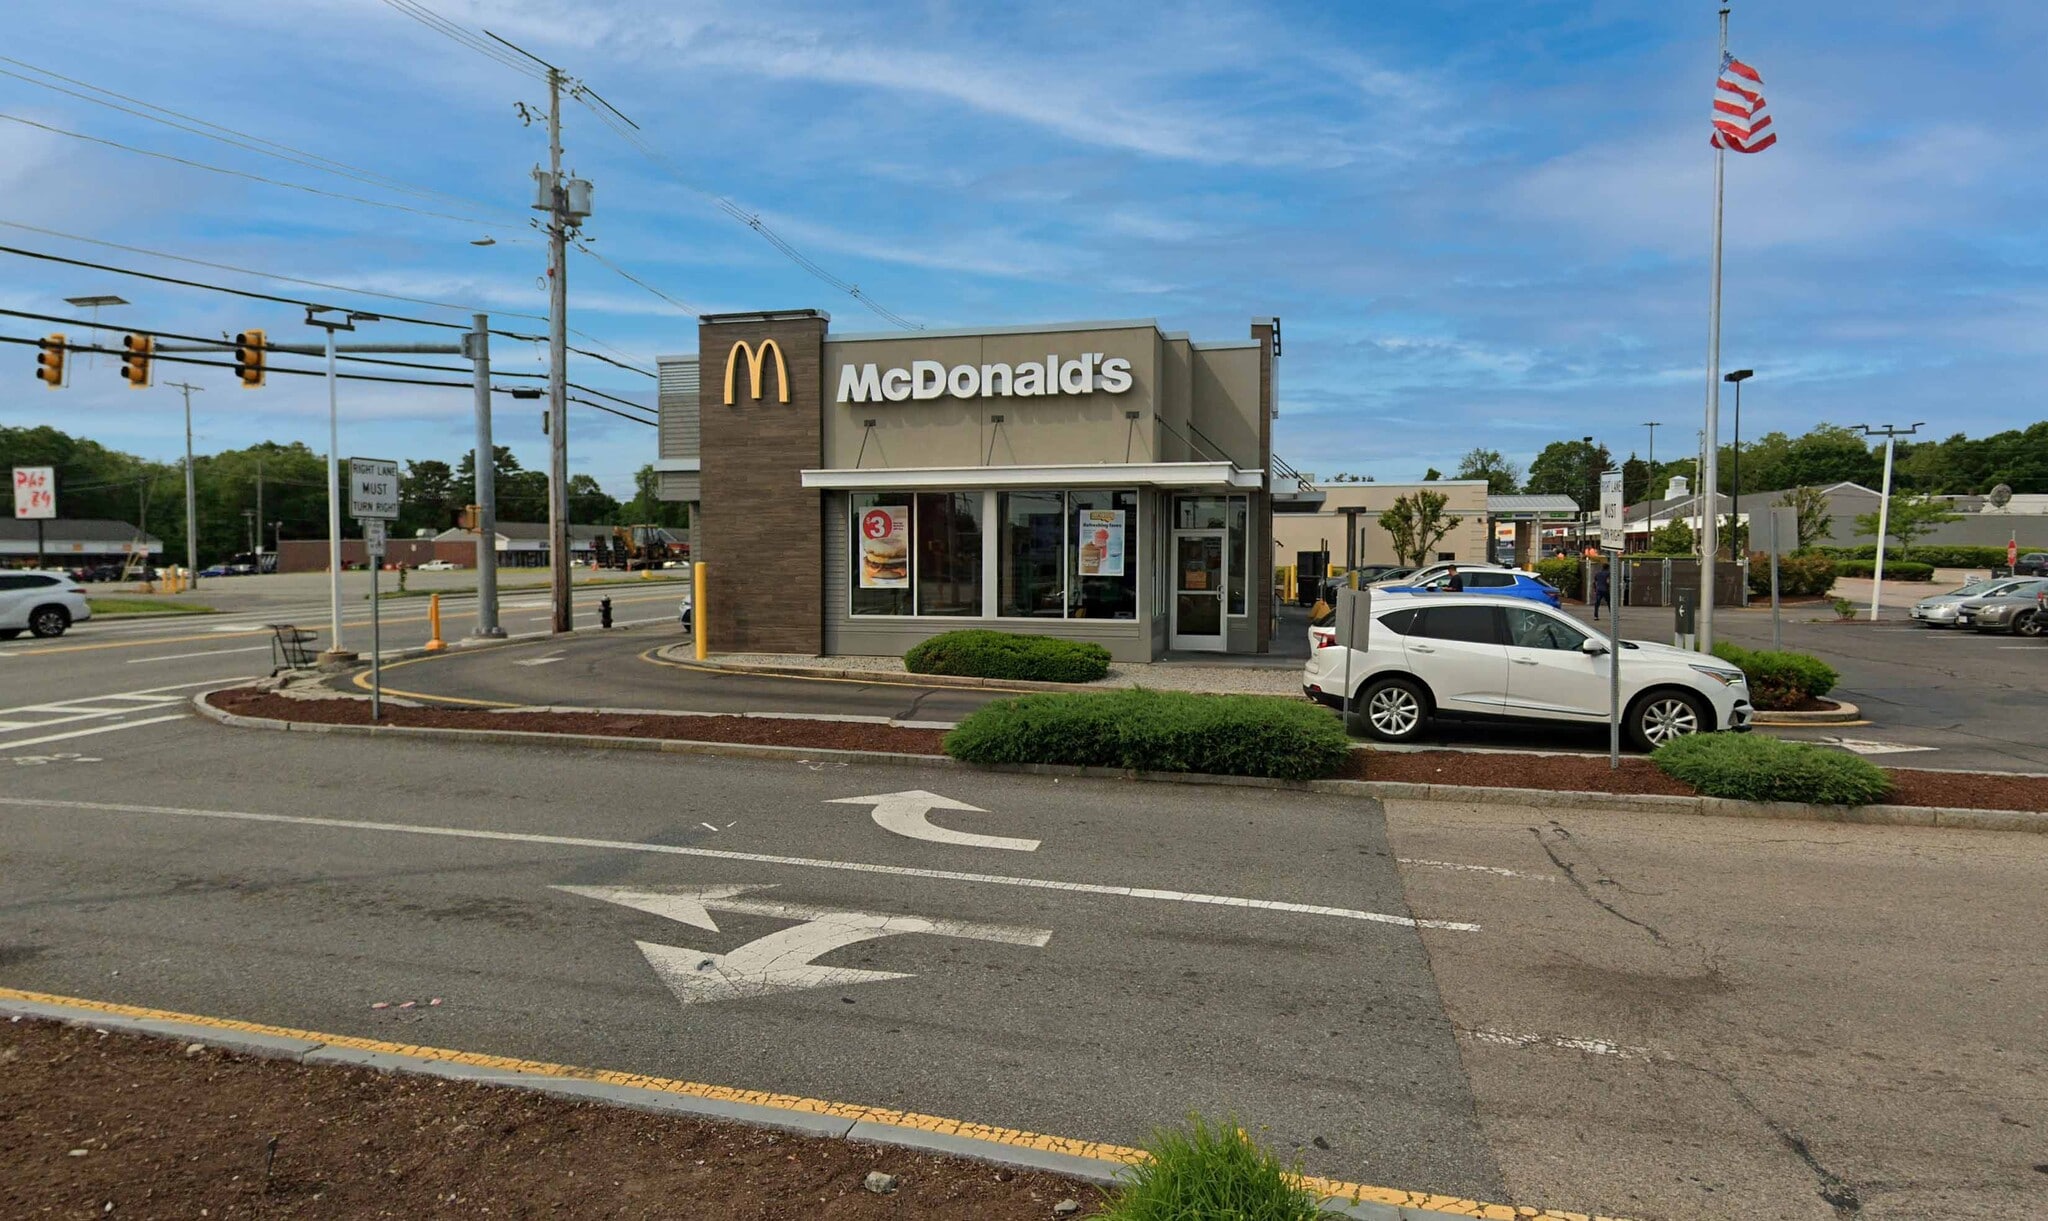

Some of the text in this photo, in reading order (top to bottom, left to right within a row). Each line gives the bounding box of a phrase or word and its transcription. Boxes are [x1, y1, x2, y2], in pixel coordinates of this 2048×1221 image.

[836, 352, 1133, 402] McDonald's
[353, 463, 396, 476] RIGHT LANE
[362, 482, 387, 495] MUST
[353, 501, 396, 513] TURN RIGHT
